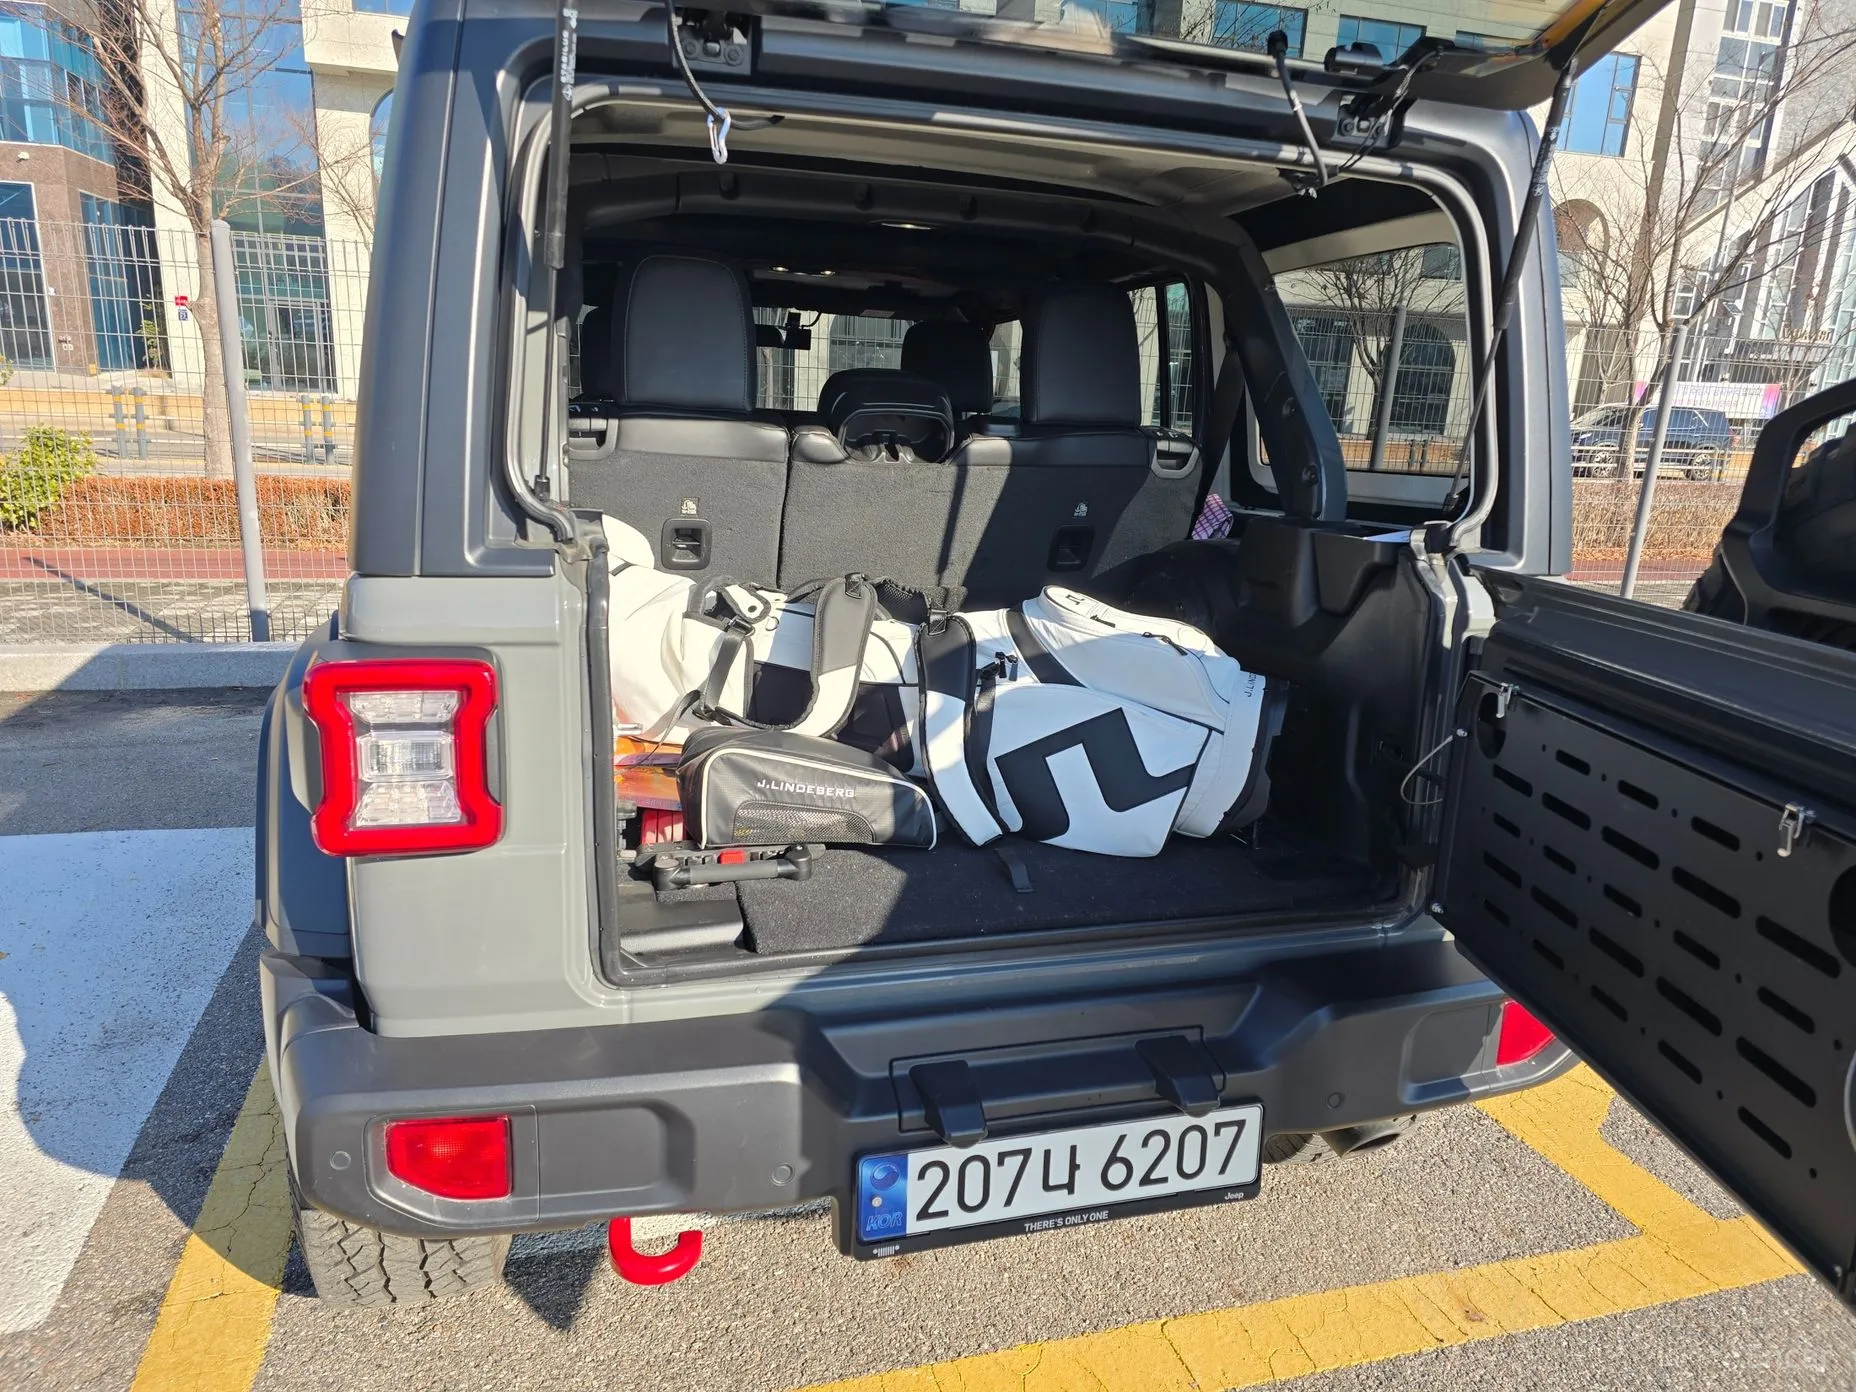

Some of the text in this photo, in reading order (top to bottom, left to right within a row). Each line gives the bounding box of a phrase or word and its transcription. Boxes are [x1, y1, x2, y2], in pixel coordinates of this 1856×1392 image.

[757, 779, 855, 798] J.LINDEBERG
[915, 1119, 1247, 1222] 207나 6207
[1224, 1192, 1244, 1200] Jeep
[865, 1211, 903, 1232] KOR
[1023, 1210, 1109, 1232] THERE'S ONLY ONE
